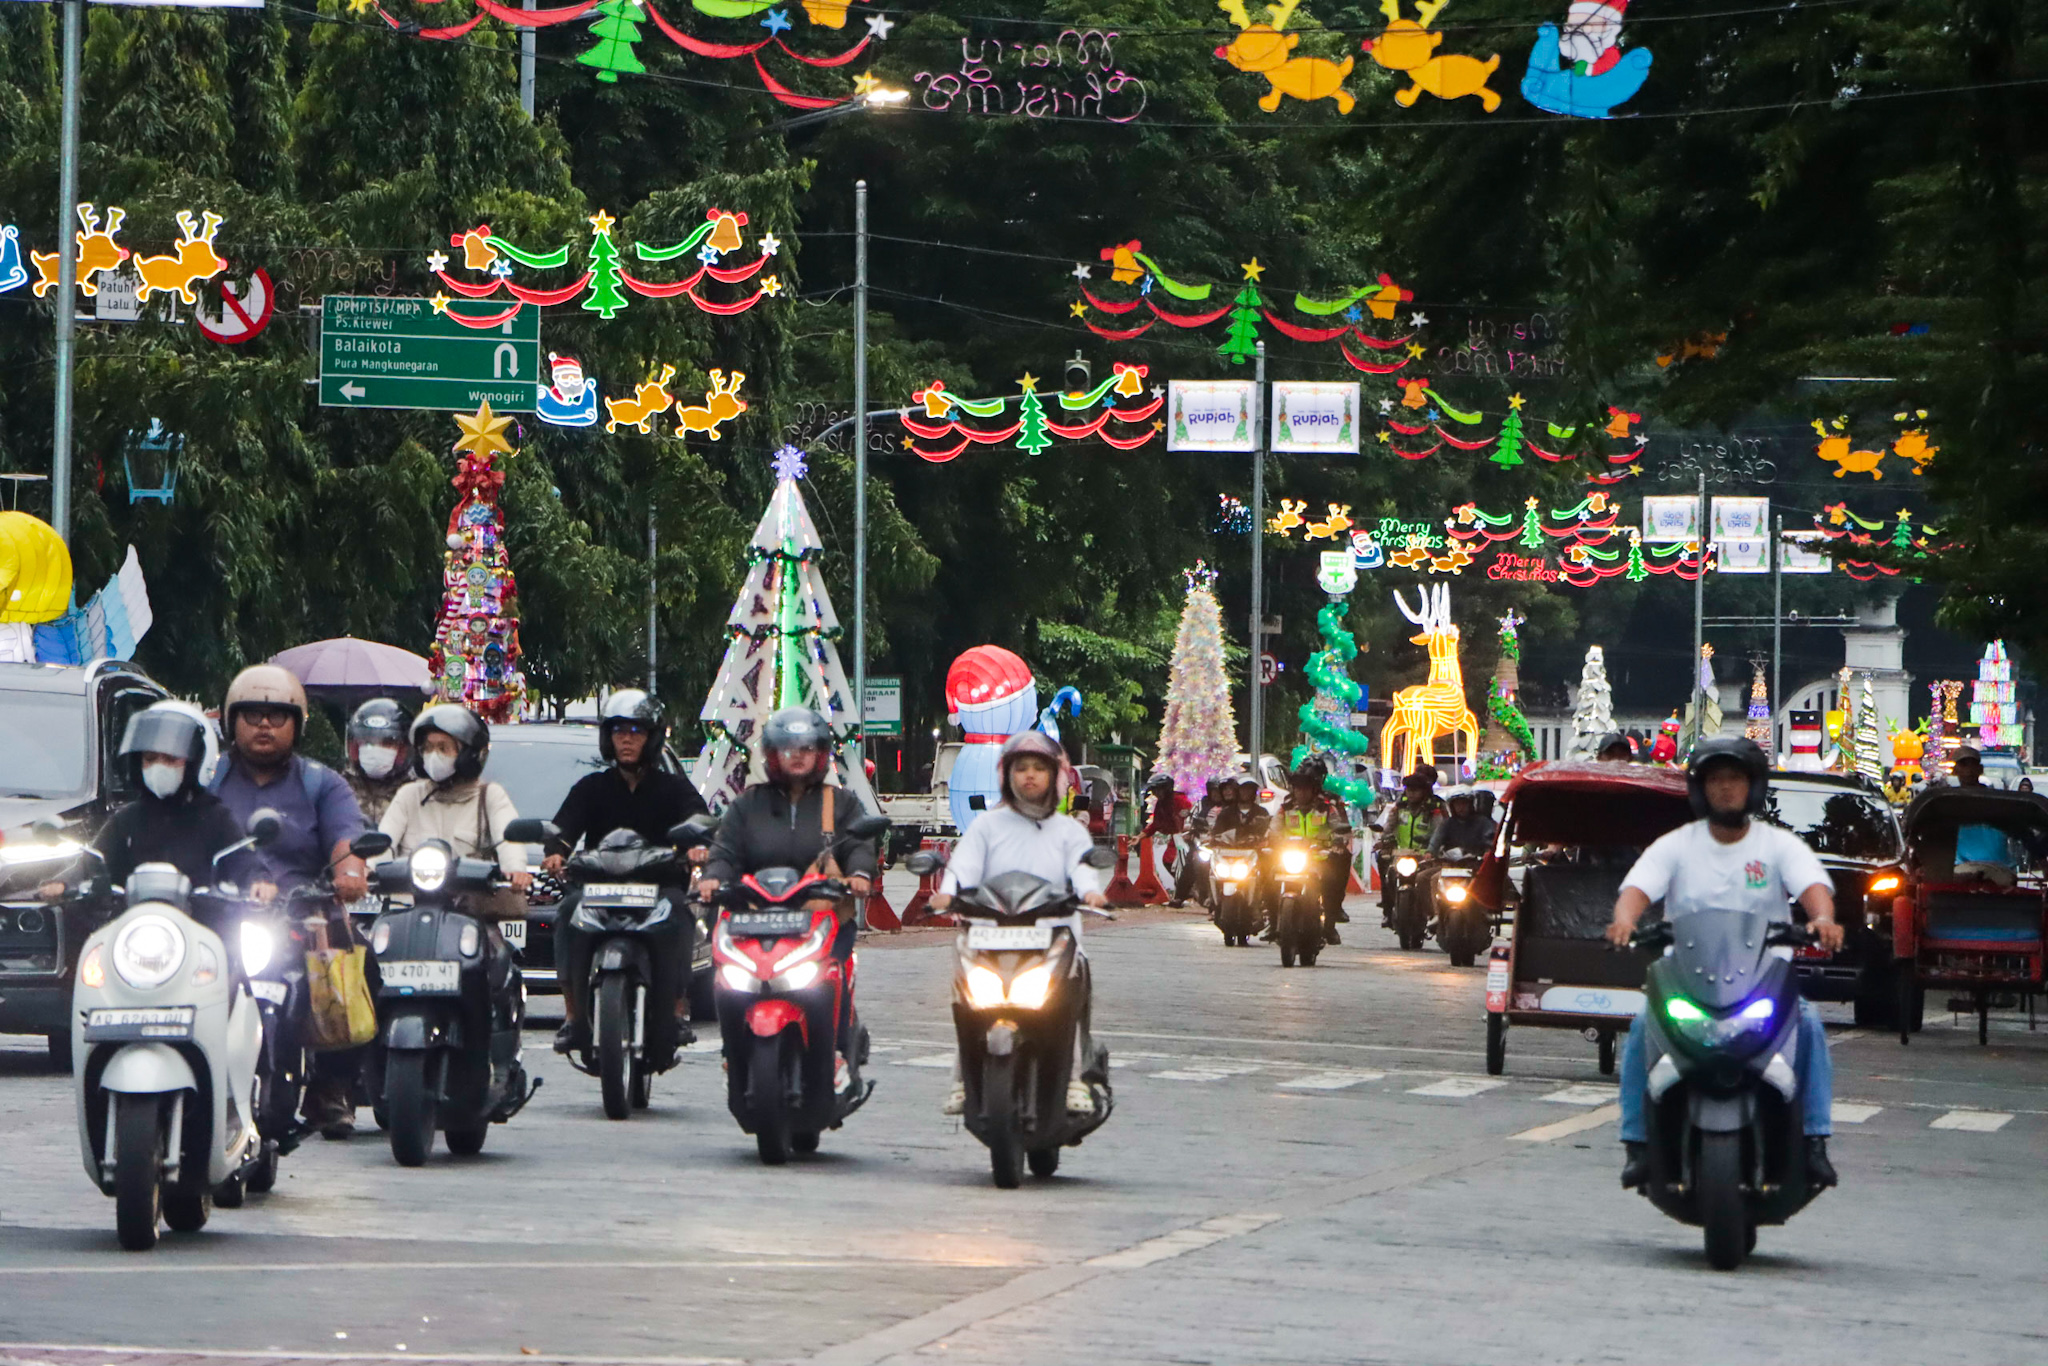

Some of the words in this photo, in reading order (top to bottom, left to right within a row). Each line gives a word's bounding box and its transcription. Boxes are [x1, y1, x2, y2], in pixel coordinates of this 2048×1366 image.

[107, 298, 130, 311] Lalu
[334, 338, 402, 354] Balaikota
[334, 357, 358, 369] Pura
[361, 358, 439, 374] Mangkunegaran
[468, 390, 525, 405] Wonogiri
[1188, 411, 1236, 426] Rupiah
[1292, 413, 1340, 427] Rupiah
[1378, 517, 1431, 540] Merry
[1496, 552, 1545, 573] Merry
[1486, 563, 1559, 584] Christmas
[504, 922, 523, 938] DU
[401, 965, 431, 977] 4707
